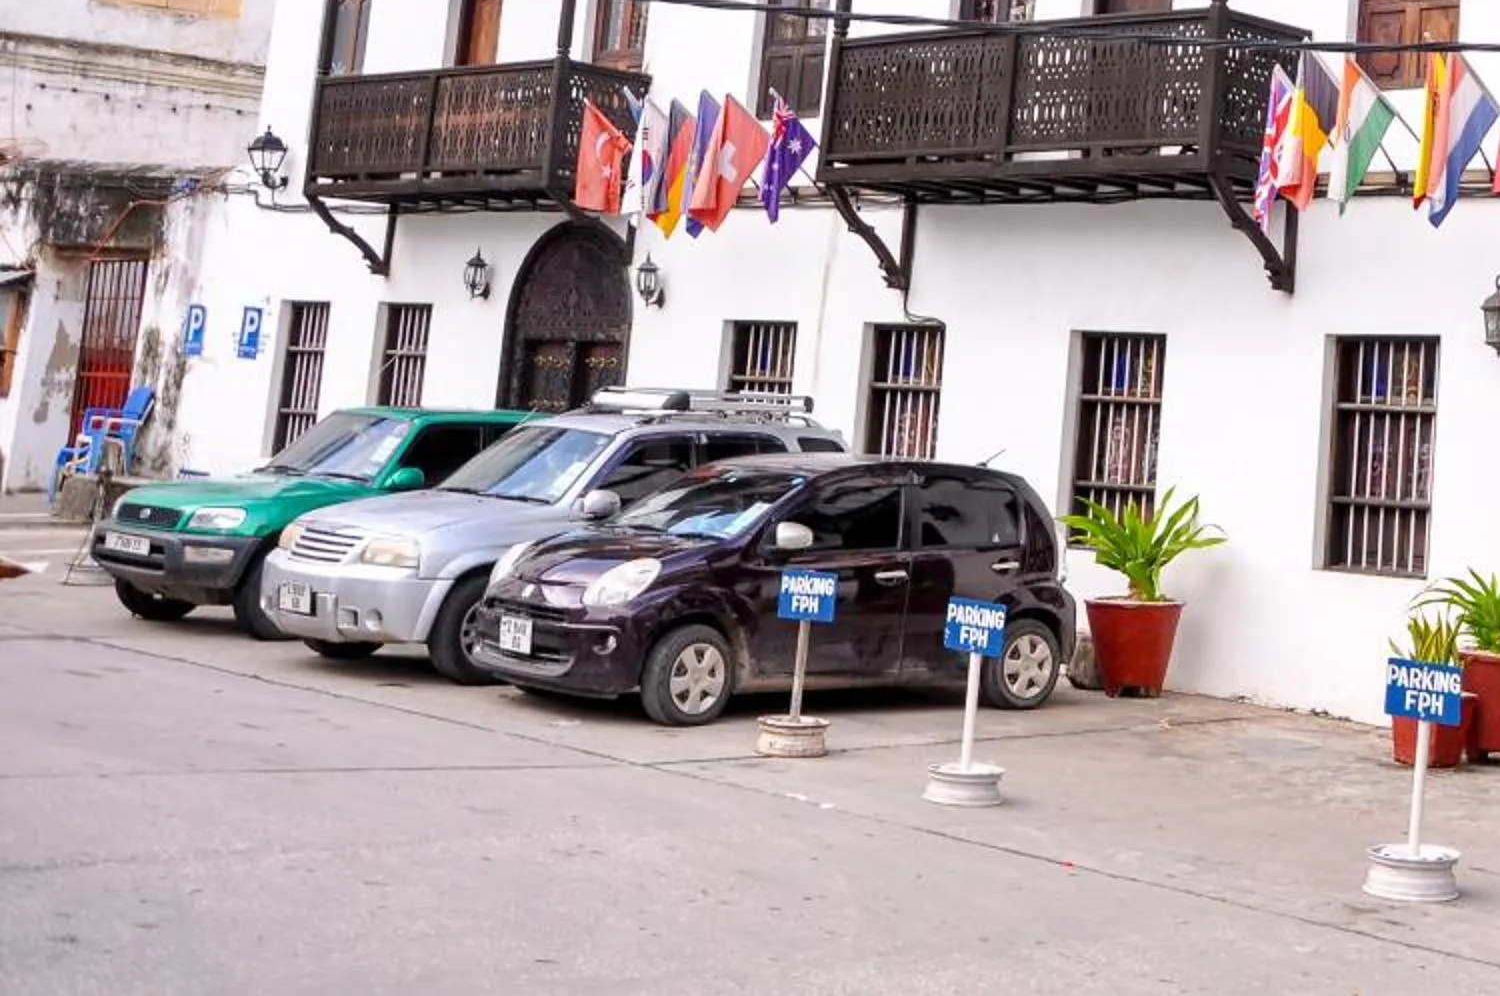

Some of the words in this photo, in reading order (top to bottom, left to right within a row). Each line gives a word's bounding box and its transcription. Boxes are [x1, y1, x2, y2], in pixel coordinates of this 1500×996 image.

[188, 307, 203, 340] P
[243, 310, 259, 344] P
[781, 575, 835, 596] PARKING
[791, 595, 819, 614] FPH
[947, 603, 1005, 631] PARKING
[960, 625, 989, 649] FPH
[1387, 664, 1462, 695] PARKING
[1404, 689, 1445, 717] FPH
